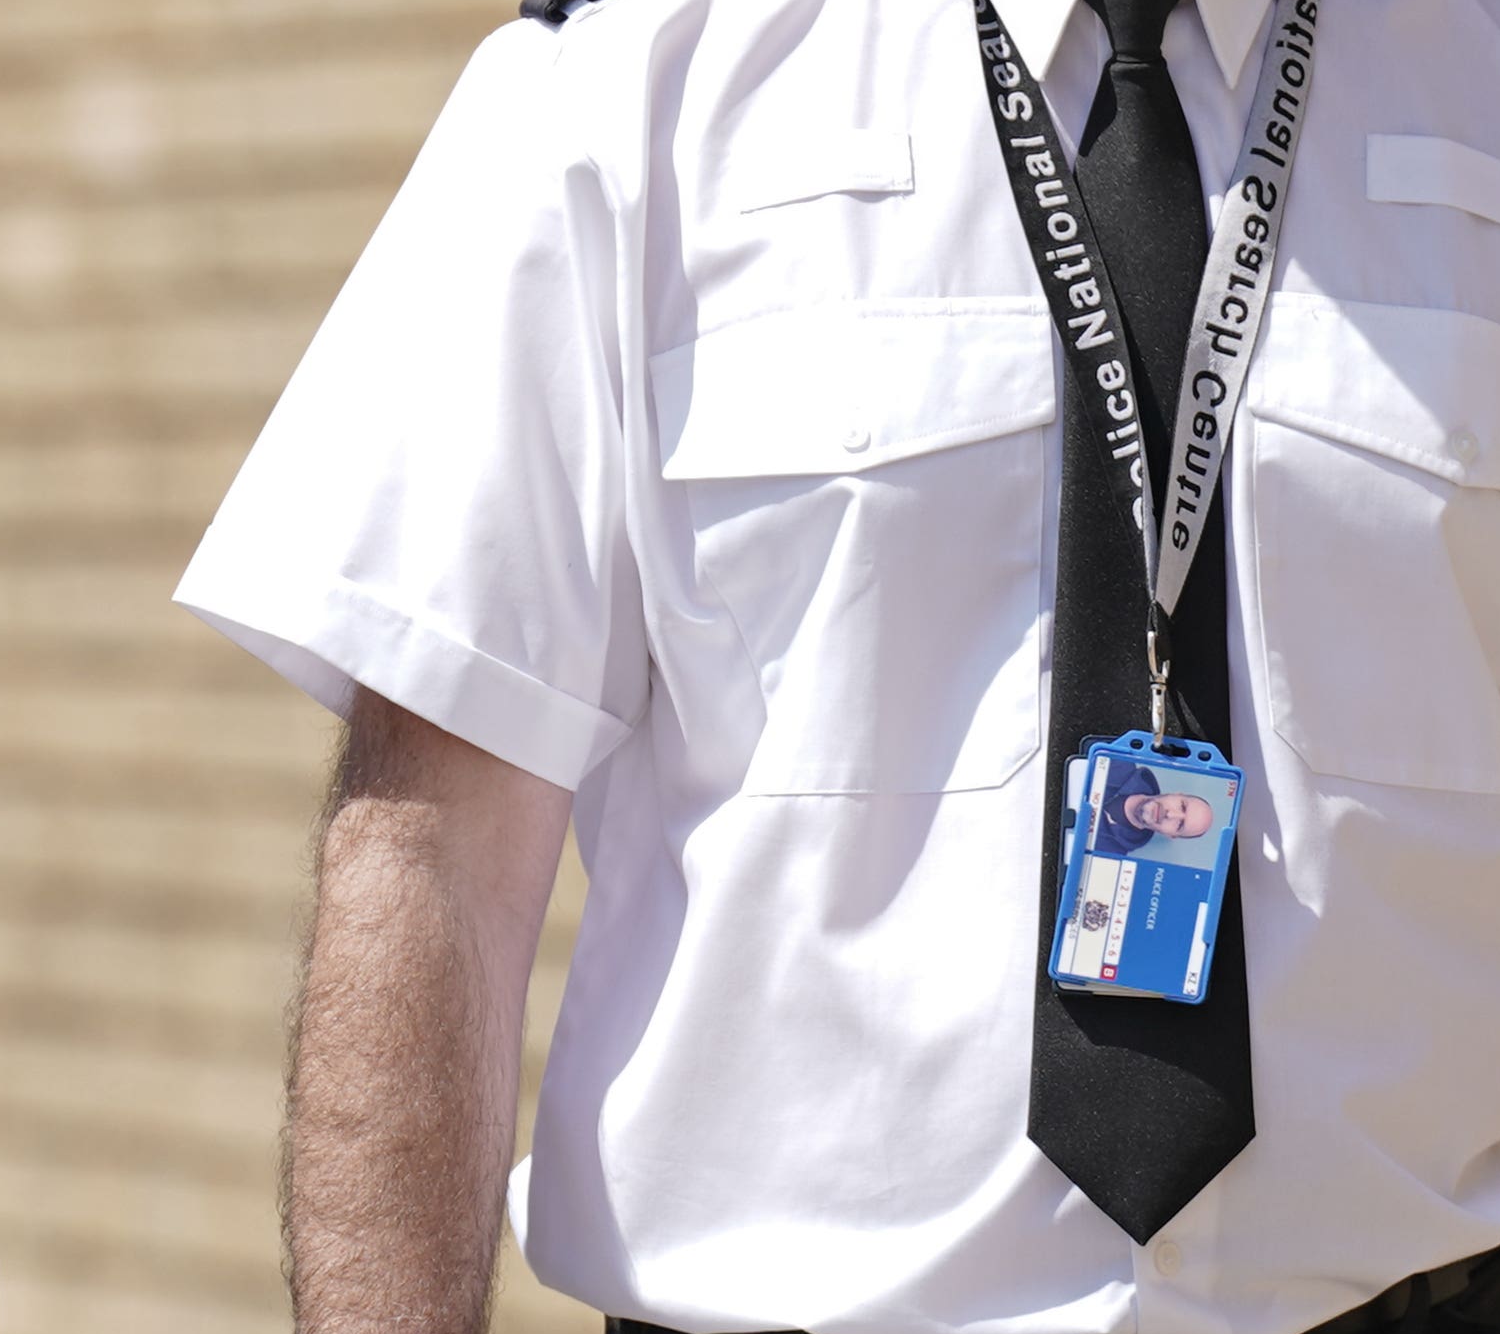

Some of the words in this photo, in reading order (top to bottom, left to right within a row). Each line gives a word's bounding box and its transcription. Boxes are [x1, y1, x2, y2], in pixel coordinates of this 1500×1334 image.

[1009, 134, 1116, 351] National
[1152, 867, 1165, 896] POLICE
[1145, 897, 1159, 930] OFFICER
